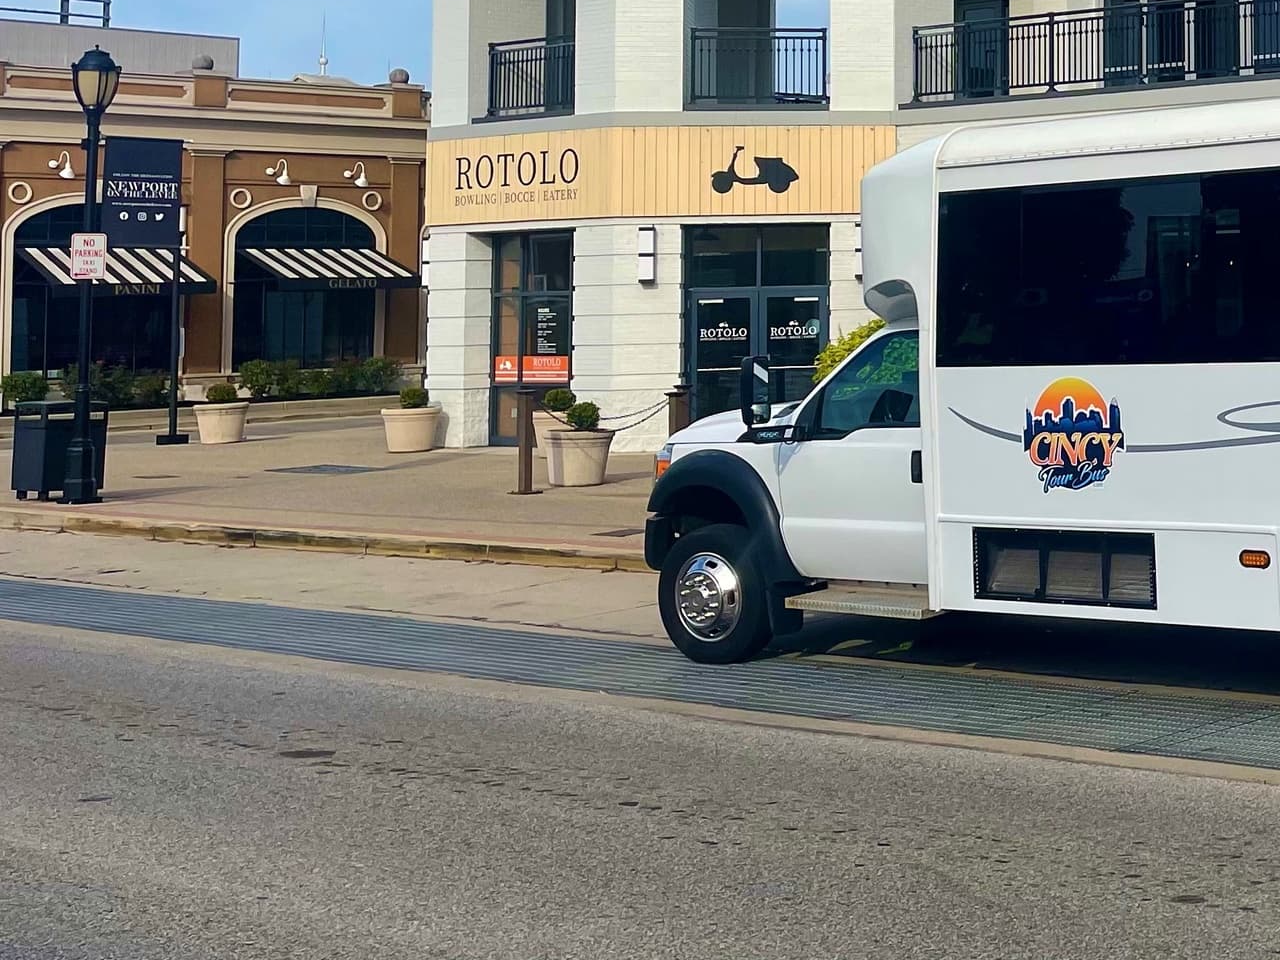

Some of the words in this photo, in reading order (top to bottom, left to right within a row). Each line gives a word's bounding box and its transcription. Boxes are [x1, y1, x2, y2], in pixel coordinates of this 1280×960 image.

[455, 148, 579, 190] ROTOLO
[108, 180, 178, 193] NEWPORT
[455, 193, 497, 207] BOWLING
[504, 191, 535, 204] BOCCE
[543, 188, 578, 201] EATERY
[83, 239, 95, 247] NO
[74, 249, 103, 258] PARKING
[328, 278, 378, 289] GELATO
[114, 284, 160, 295] PANINI
[700, 328, 747, 337] ROTOLO
[770, 326, 817, 336] ROTOLO
[533, 357, 561, 367] ROTOLO
[1029, 432, 1121, 466] CINCY
[1039, 465, 1073, 493] Tour
[1071, 458, 1108, 489] Bus
